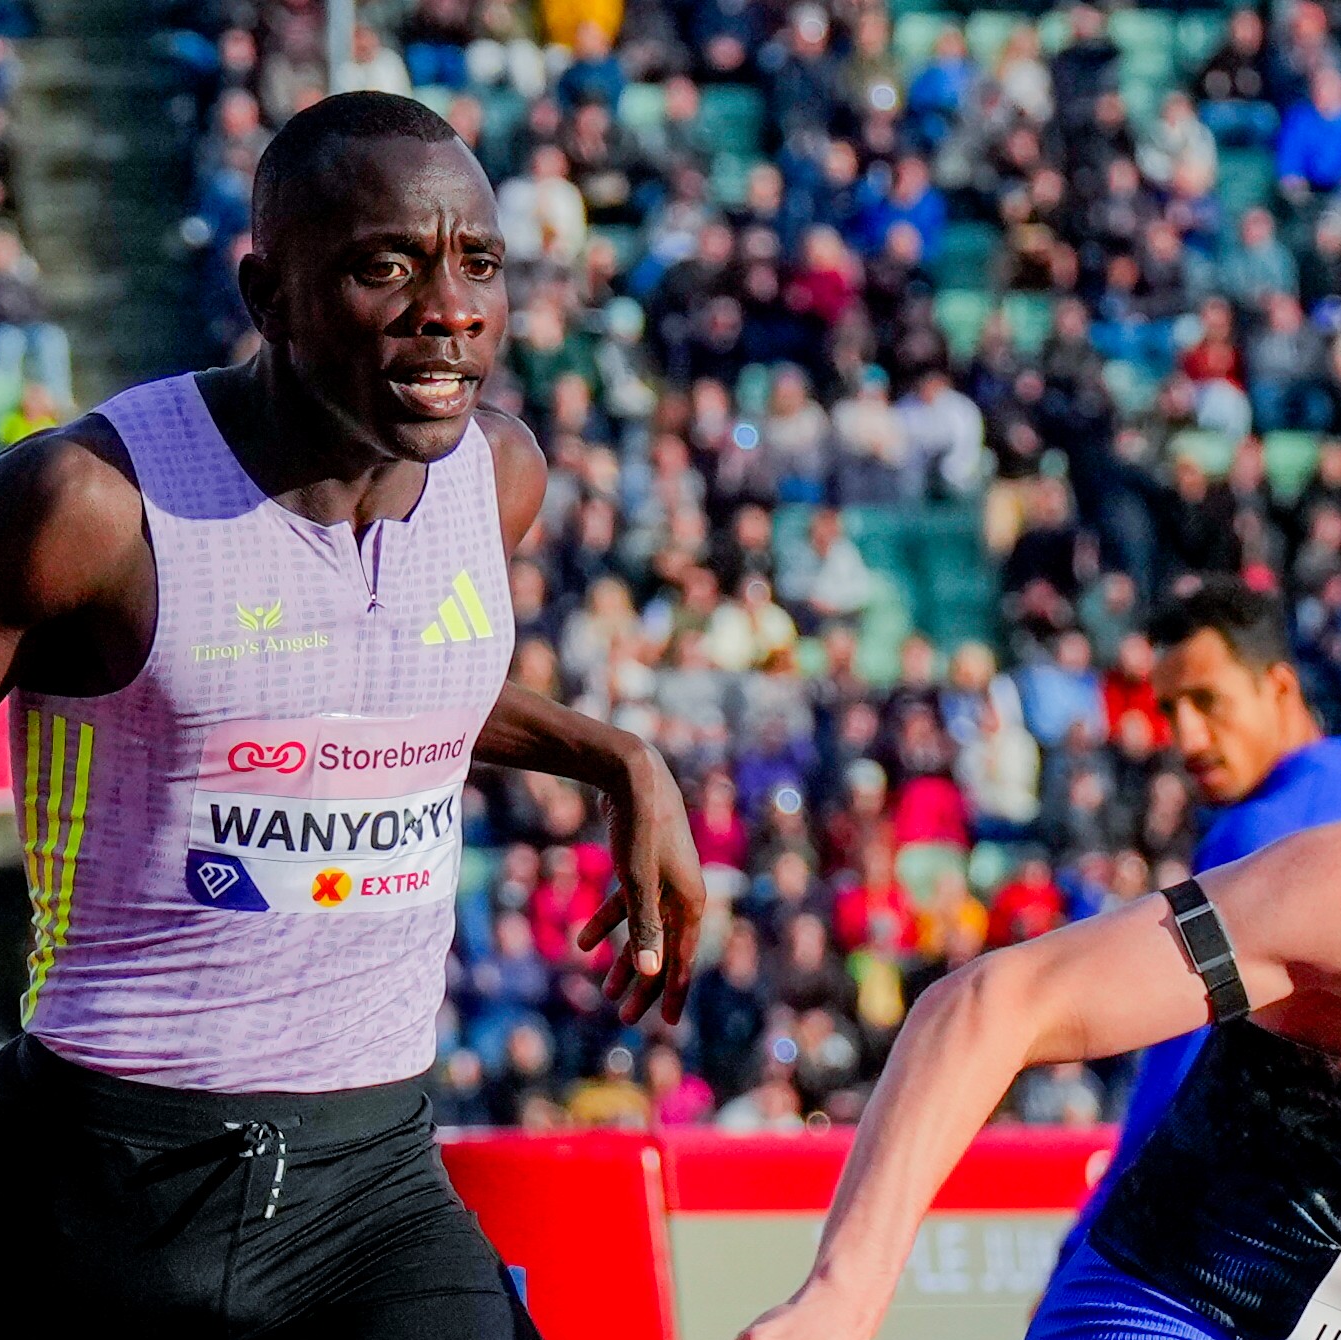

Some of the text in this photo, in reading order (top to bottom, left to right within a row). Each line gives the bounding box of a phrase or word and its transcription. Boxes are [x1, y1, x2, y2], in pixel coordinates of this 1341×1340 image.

[191, 631, 329, 663] Tirop's Angels
[318, 733, 466, 771] Storebrand
[360, 869, 430, 896] EXTRA
